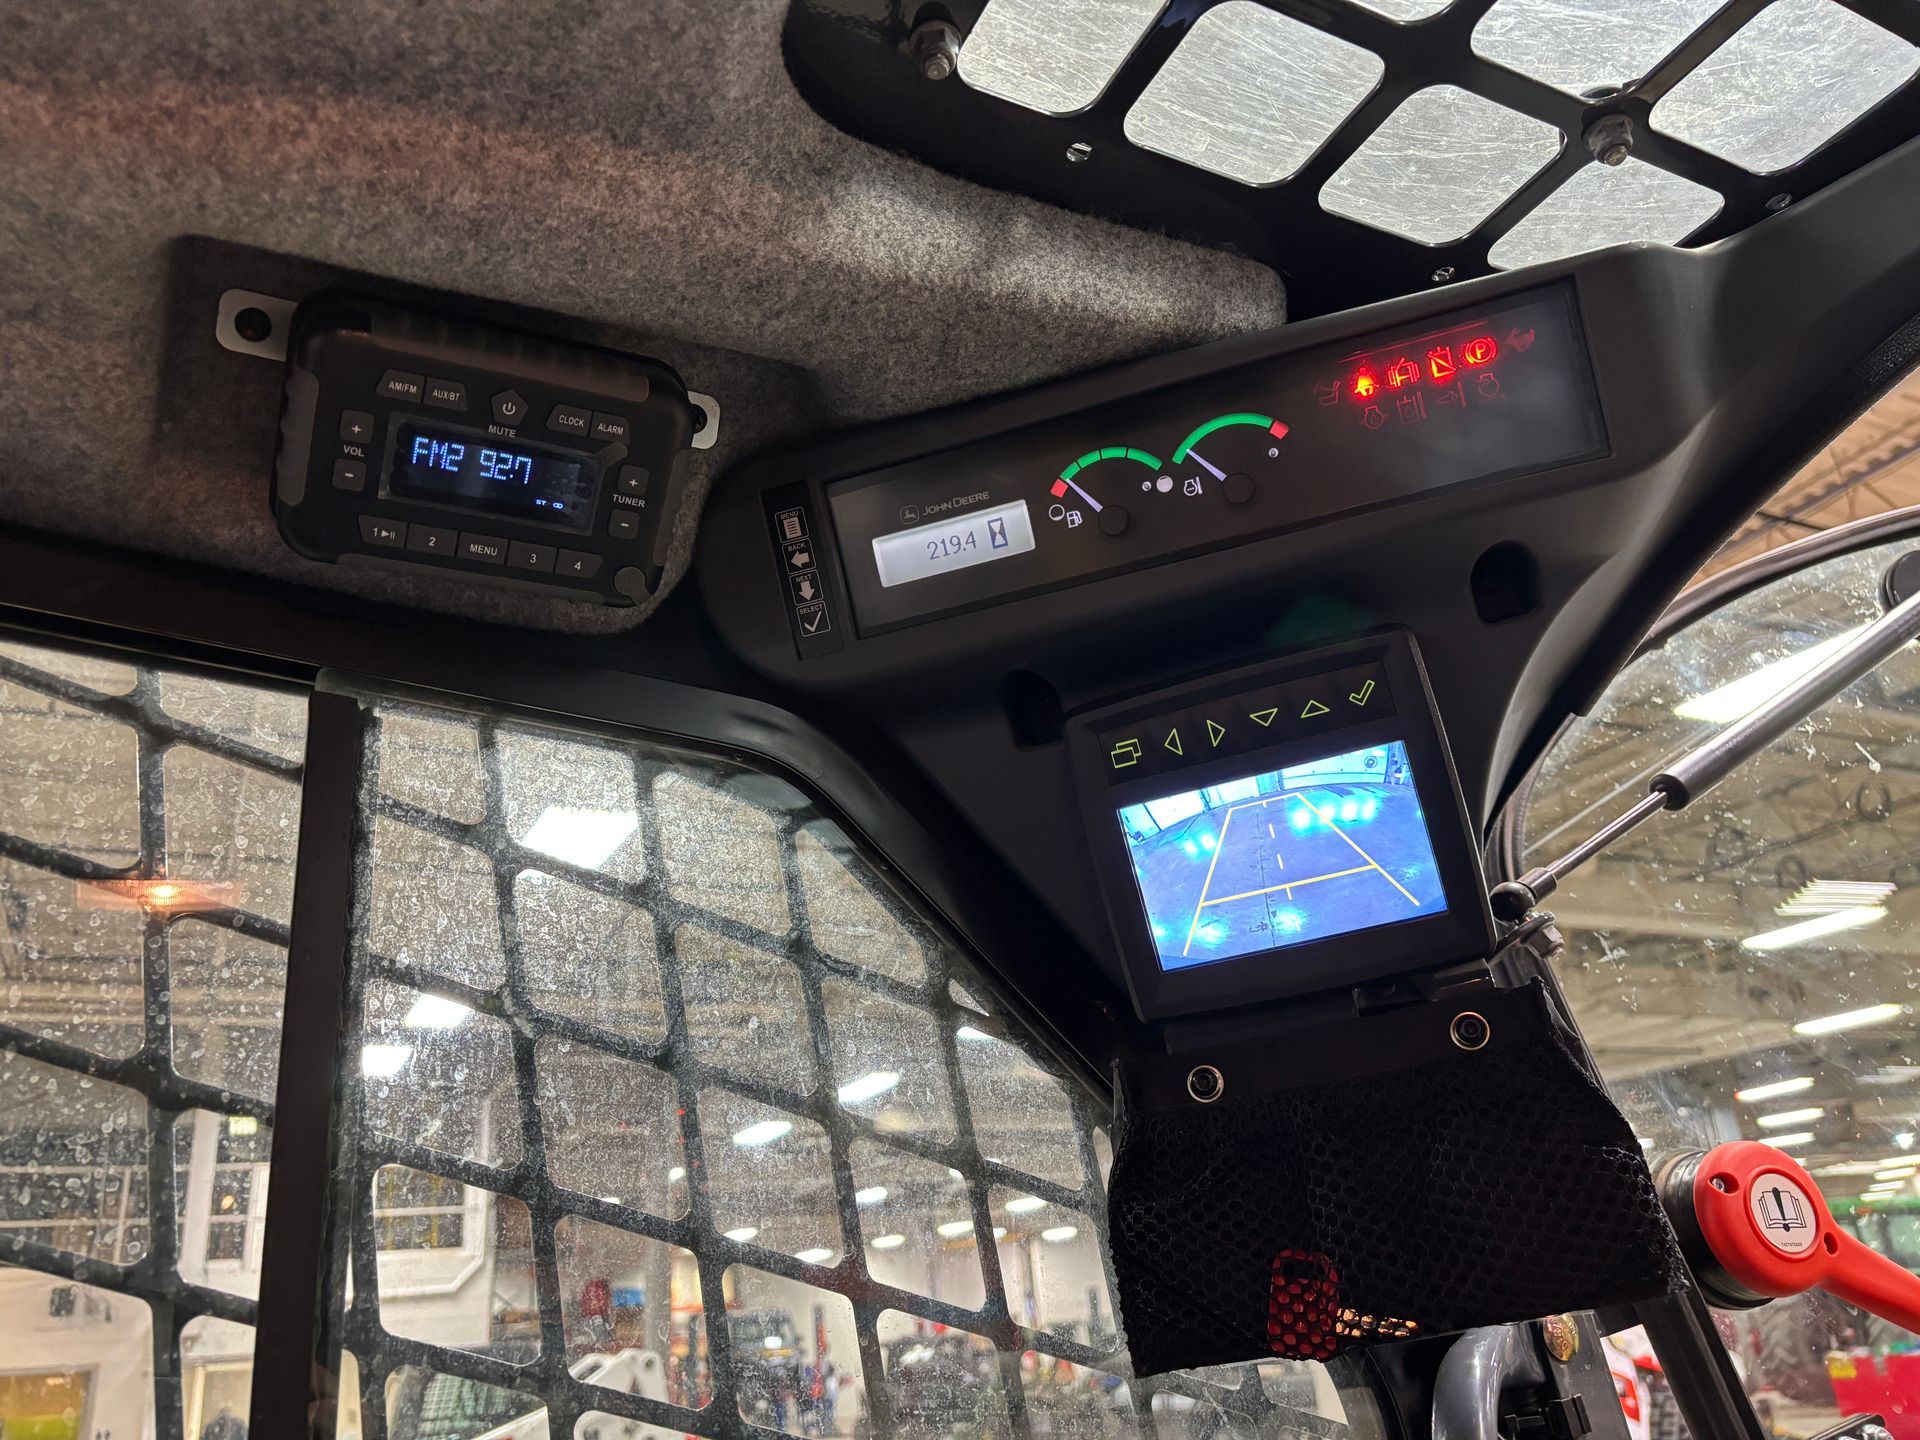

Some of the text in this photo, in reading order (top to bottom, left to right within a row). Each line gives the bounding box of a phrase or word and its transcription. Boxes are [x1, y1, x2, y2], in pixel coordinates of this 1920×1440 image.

[388, 381, 417, 395] AM/FM
[432, 388, 460, 402] AUX/BT
[558, 414, 584, 428] CLOCK
[487, 424, 517, 438] MUTE
[597, 423, 623, 435] ALARM
[343, 444, 365, 457] VOL
[411, 436, 532, 485] FM2 92.7
[612, 493, 646, 508] TUNER
[922, 491, 991, 516] JOHN DEERE
[780, 510, 799, 520] MENU
[372, 527, 379, 537] 1
[428, 536, 437, 546] 2
[787, 542, 806, 552] BACK
[926, 530, 977, 560] 219.4
[469, 543, 498, 556] MENU
[529, 553, 537, 564] 3
[574, 561, 582, 571] 4
[795, 573, 813, 583] NEXT
[799, 603, 823, 615] SELECT
